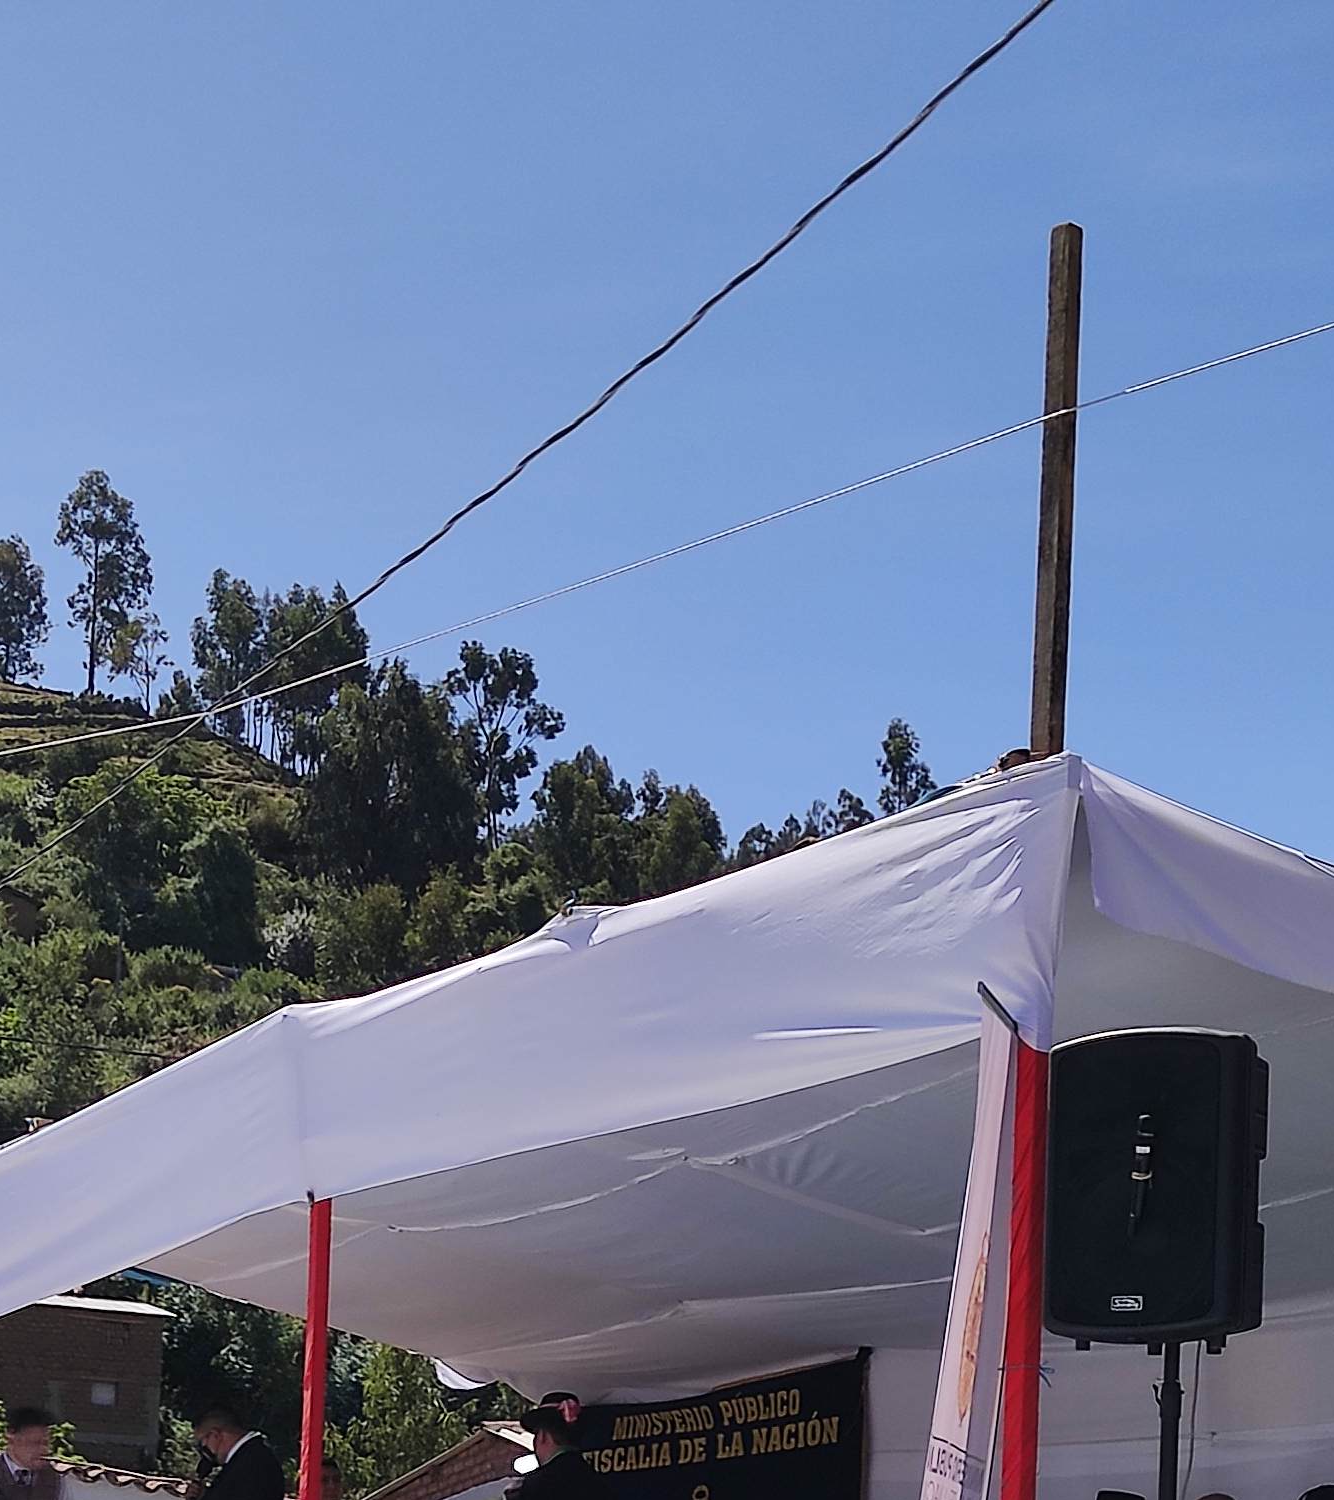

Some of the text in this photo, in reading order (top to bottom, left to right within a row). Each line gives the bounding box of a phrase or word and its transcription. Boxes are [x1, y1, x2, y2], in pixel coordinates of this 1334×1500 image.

[611, 1388, 800, 1441] MINISTERIO PÚBLICO
[678, 1437, 707, 1465] DE
[716, 1431, 744, 1459] LA
[752, 1411, 840, 1455] NACIÓN
